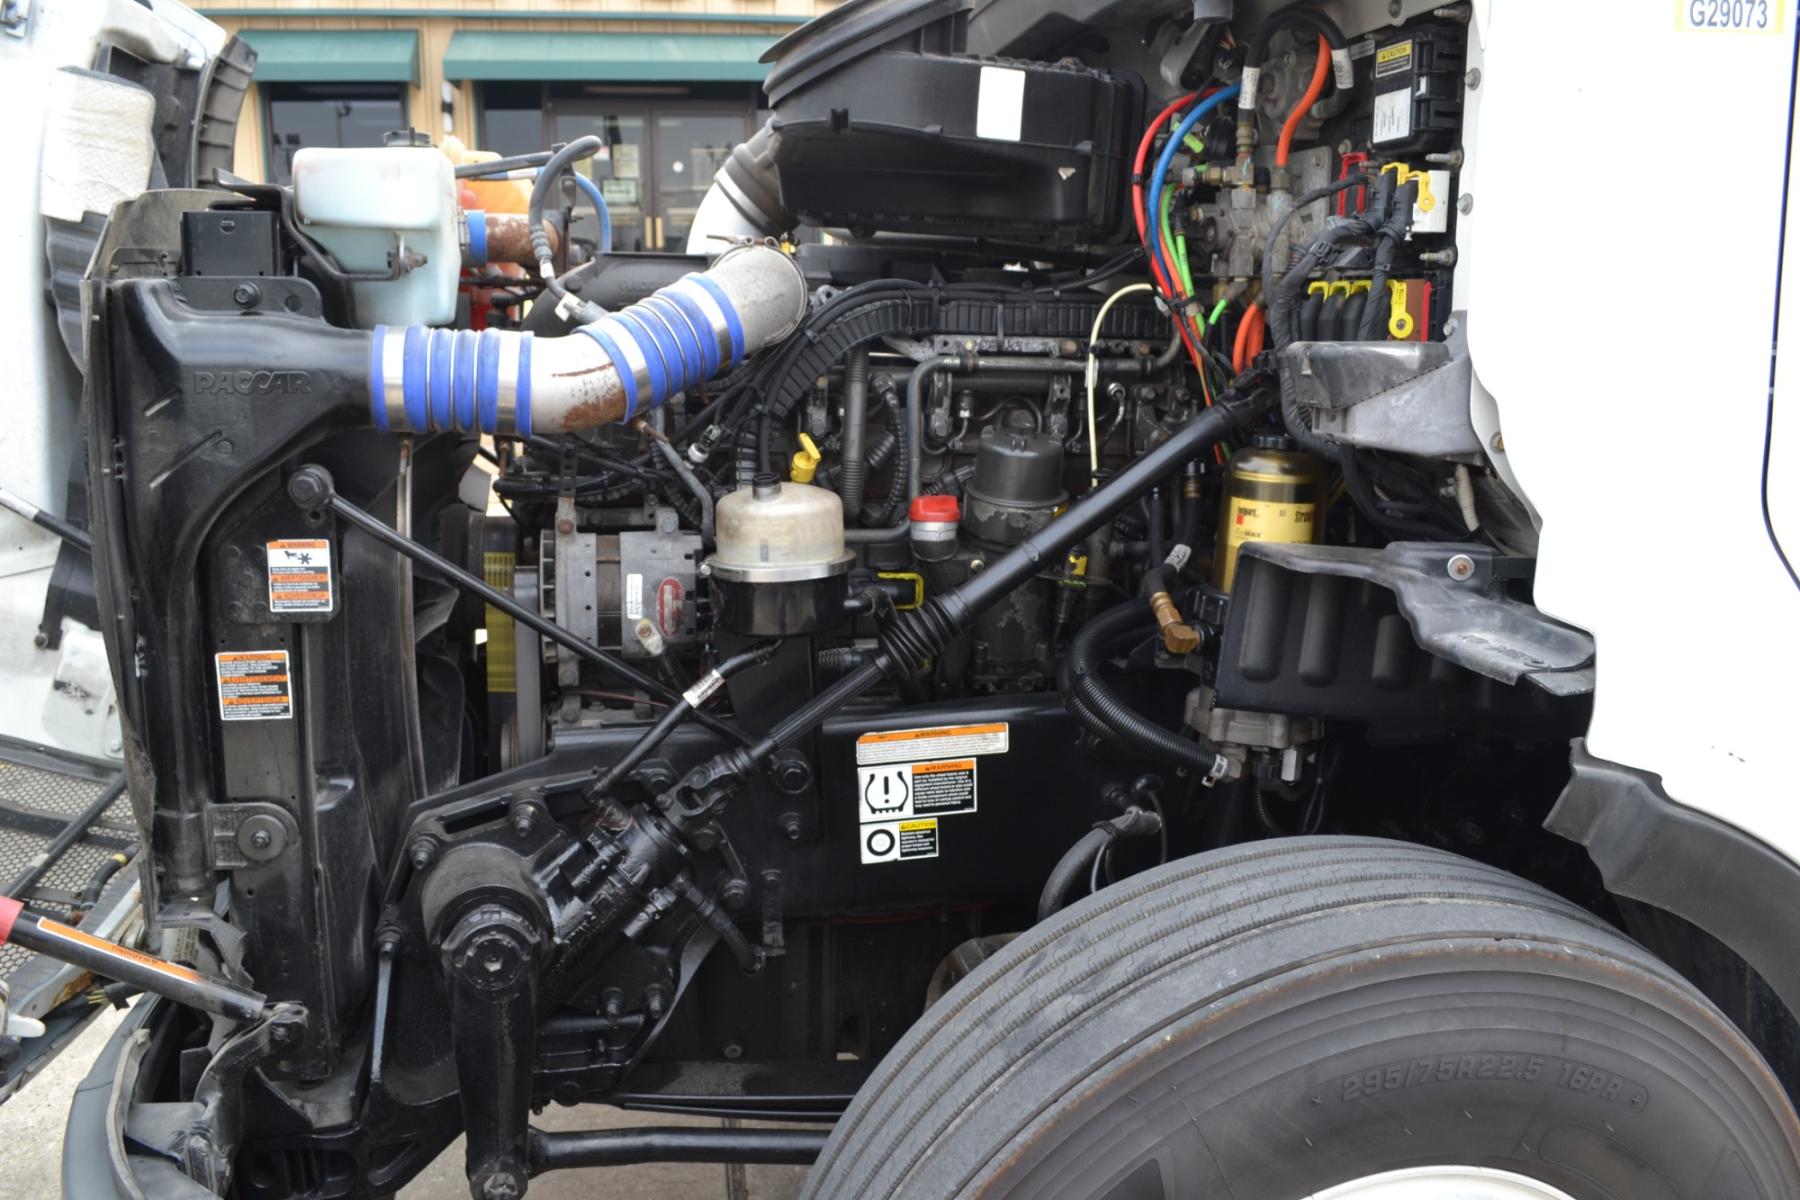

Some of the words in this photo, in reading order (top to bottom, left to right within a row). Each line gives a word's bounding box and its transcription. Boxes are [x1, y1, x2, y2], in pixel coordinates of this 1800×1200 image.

[1690, 0, 1768, 28] G29073
[193, 369, 312, 395] PACCAR
[920, 729, 952, 738] WARNING
[931, 761, 962, 771] WARNING
[905, 821, 936, 829] CAUTION
[1342, 1055, 1544, 1102] 295/75R22.5
[1559, 1062, 1624, 1101] 16PR
